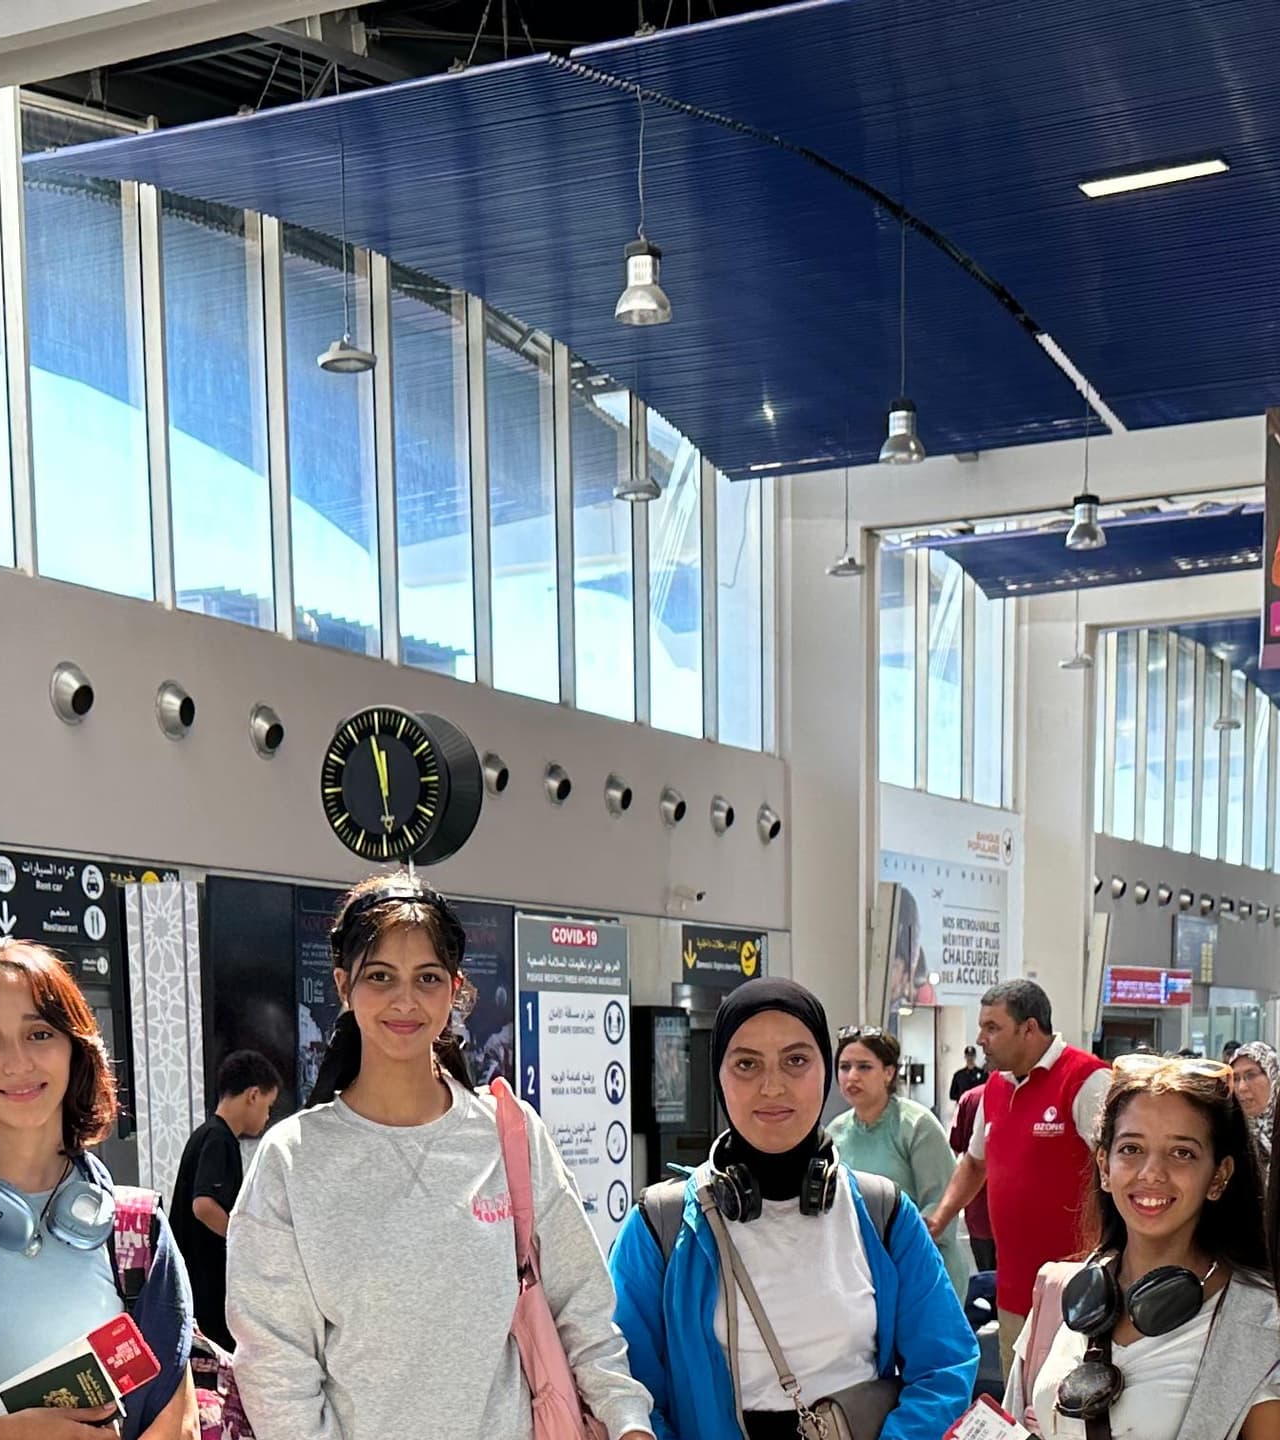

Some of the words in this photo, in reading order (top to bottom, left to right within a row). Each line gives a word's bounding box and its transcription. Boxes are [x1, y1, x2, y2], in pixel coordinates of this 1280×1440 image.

[35, 881, 50, 891] Rent
[51, 883, 63, 892] car
[42, 921, 79, 934] Restaurant
[942, 916, 955, 929] NOS
[956, 918, 1000, 933] RETROUVAILLES
[552, 928, 598, 946] COVID-19
[942, 932, 973, 947] MÉRITENT
[975, 937, 983, 948] LE
[985, 938, 1000, 949] PLUS
[942, 948, 999, 968] CHALEUREUX
[956, 968, 999, 985] ACCUEILS
[526, 1001, 533, 1031] 1
[527, 1065, 535, 1095] 2
